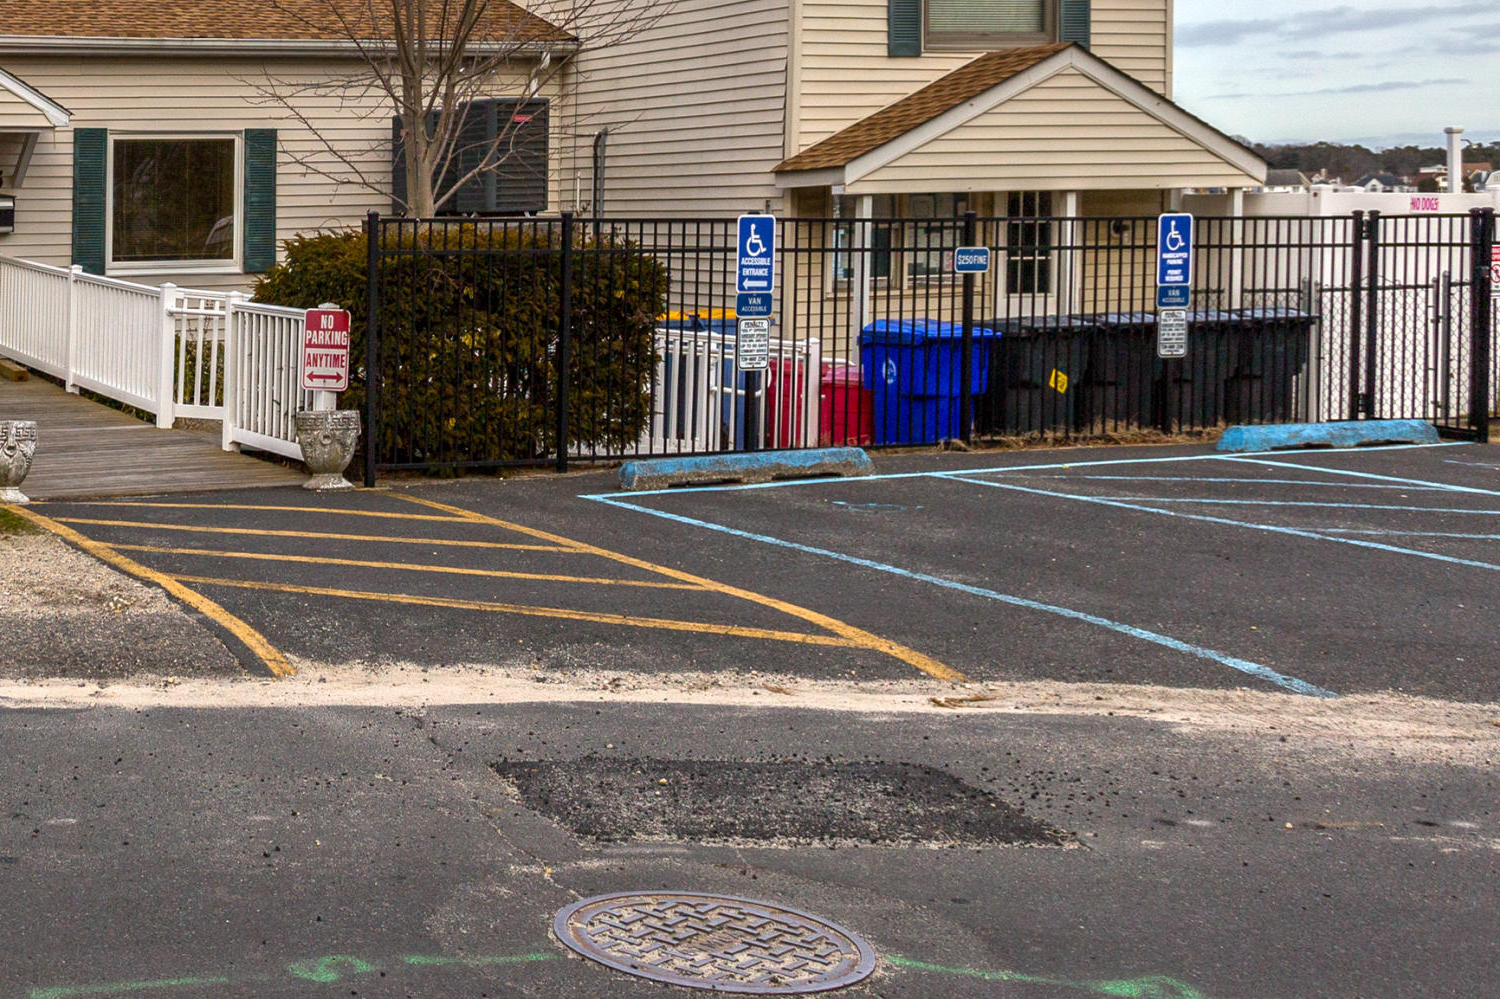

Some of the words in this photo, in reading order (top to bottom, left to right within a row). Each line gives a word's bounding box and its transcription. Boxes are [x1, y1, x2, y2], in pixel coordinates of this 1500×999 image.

[1411, 197, 1420, 210] NO
[1421, 197, 1439, 210] DOGS
[741, 257, 771, 265] ACCESSIBLE
[957, 254, 973, 265] $250
[974, 255, 987, 264] FINE
[742, 268, 768, 276] ENTRANCE
[748, 297, 761, 305] VAN
[320, 314, 334, 329] NO
[306, 330, 348, 346] PARKING
[306, 353, 346, 369] ANYTIME
